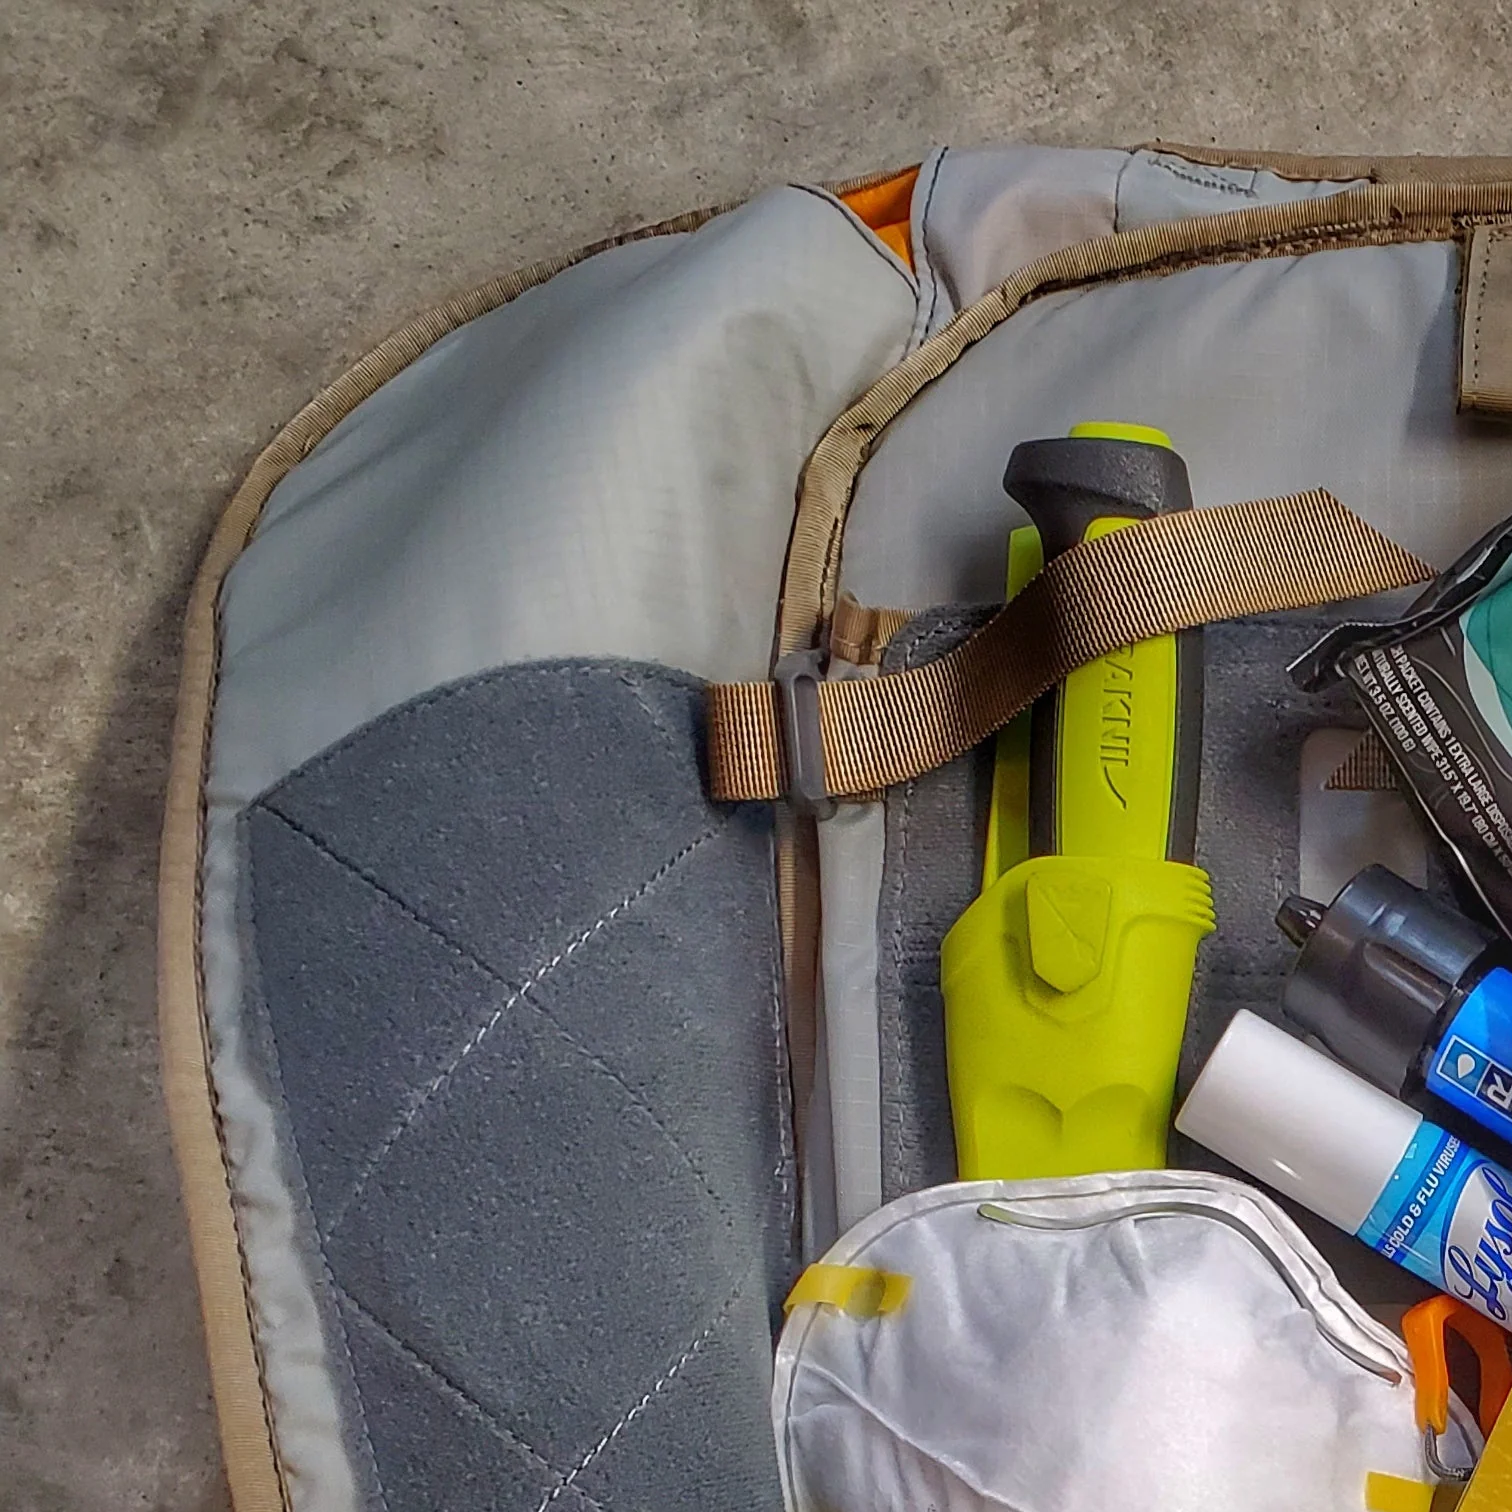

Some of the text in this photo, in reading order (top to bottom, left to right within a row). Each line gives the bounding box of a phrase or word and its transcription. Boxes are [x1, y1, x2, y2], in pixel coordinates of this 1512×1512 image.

[1393, 691, 1429, 737] SCENTED
[1419, 733, 1444, 761] WIPE
[1393, 654, 1425, 694] PACKET
[1415, 690, 1452, 739] CONTAINS
[1447, 742, 1476, 777] EXTRA
[1466, 772, 1494, 806] LARGE
[1413, 1173, 1441, 1205] FLU
[1407, 1201, 1423, 1216] &
[1387, 1211, 1417, 1248] COLD
